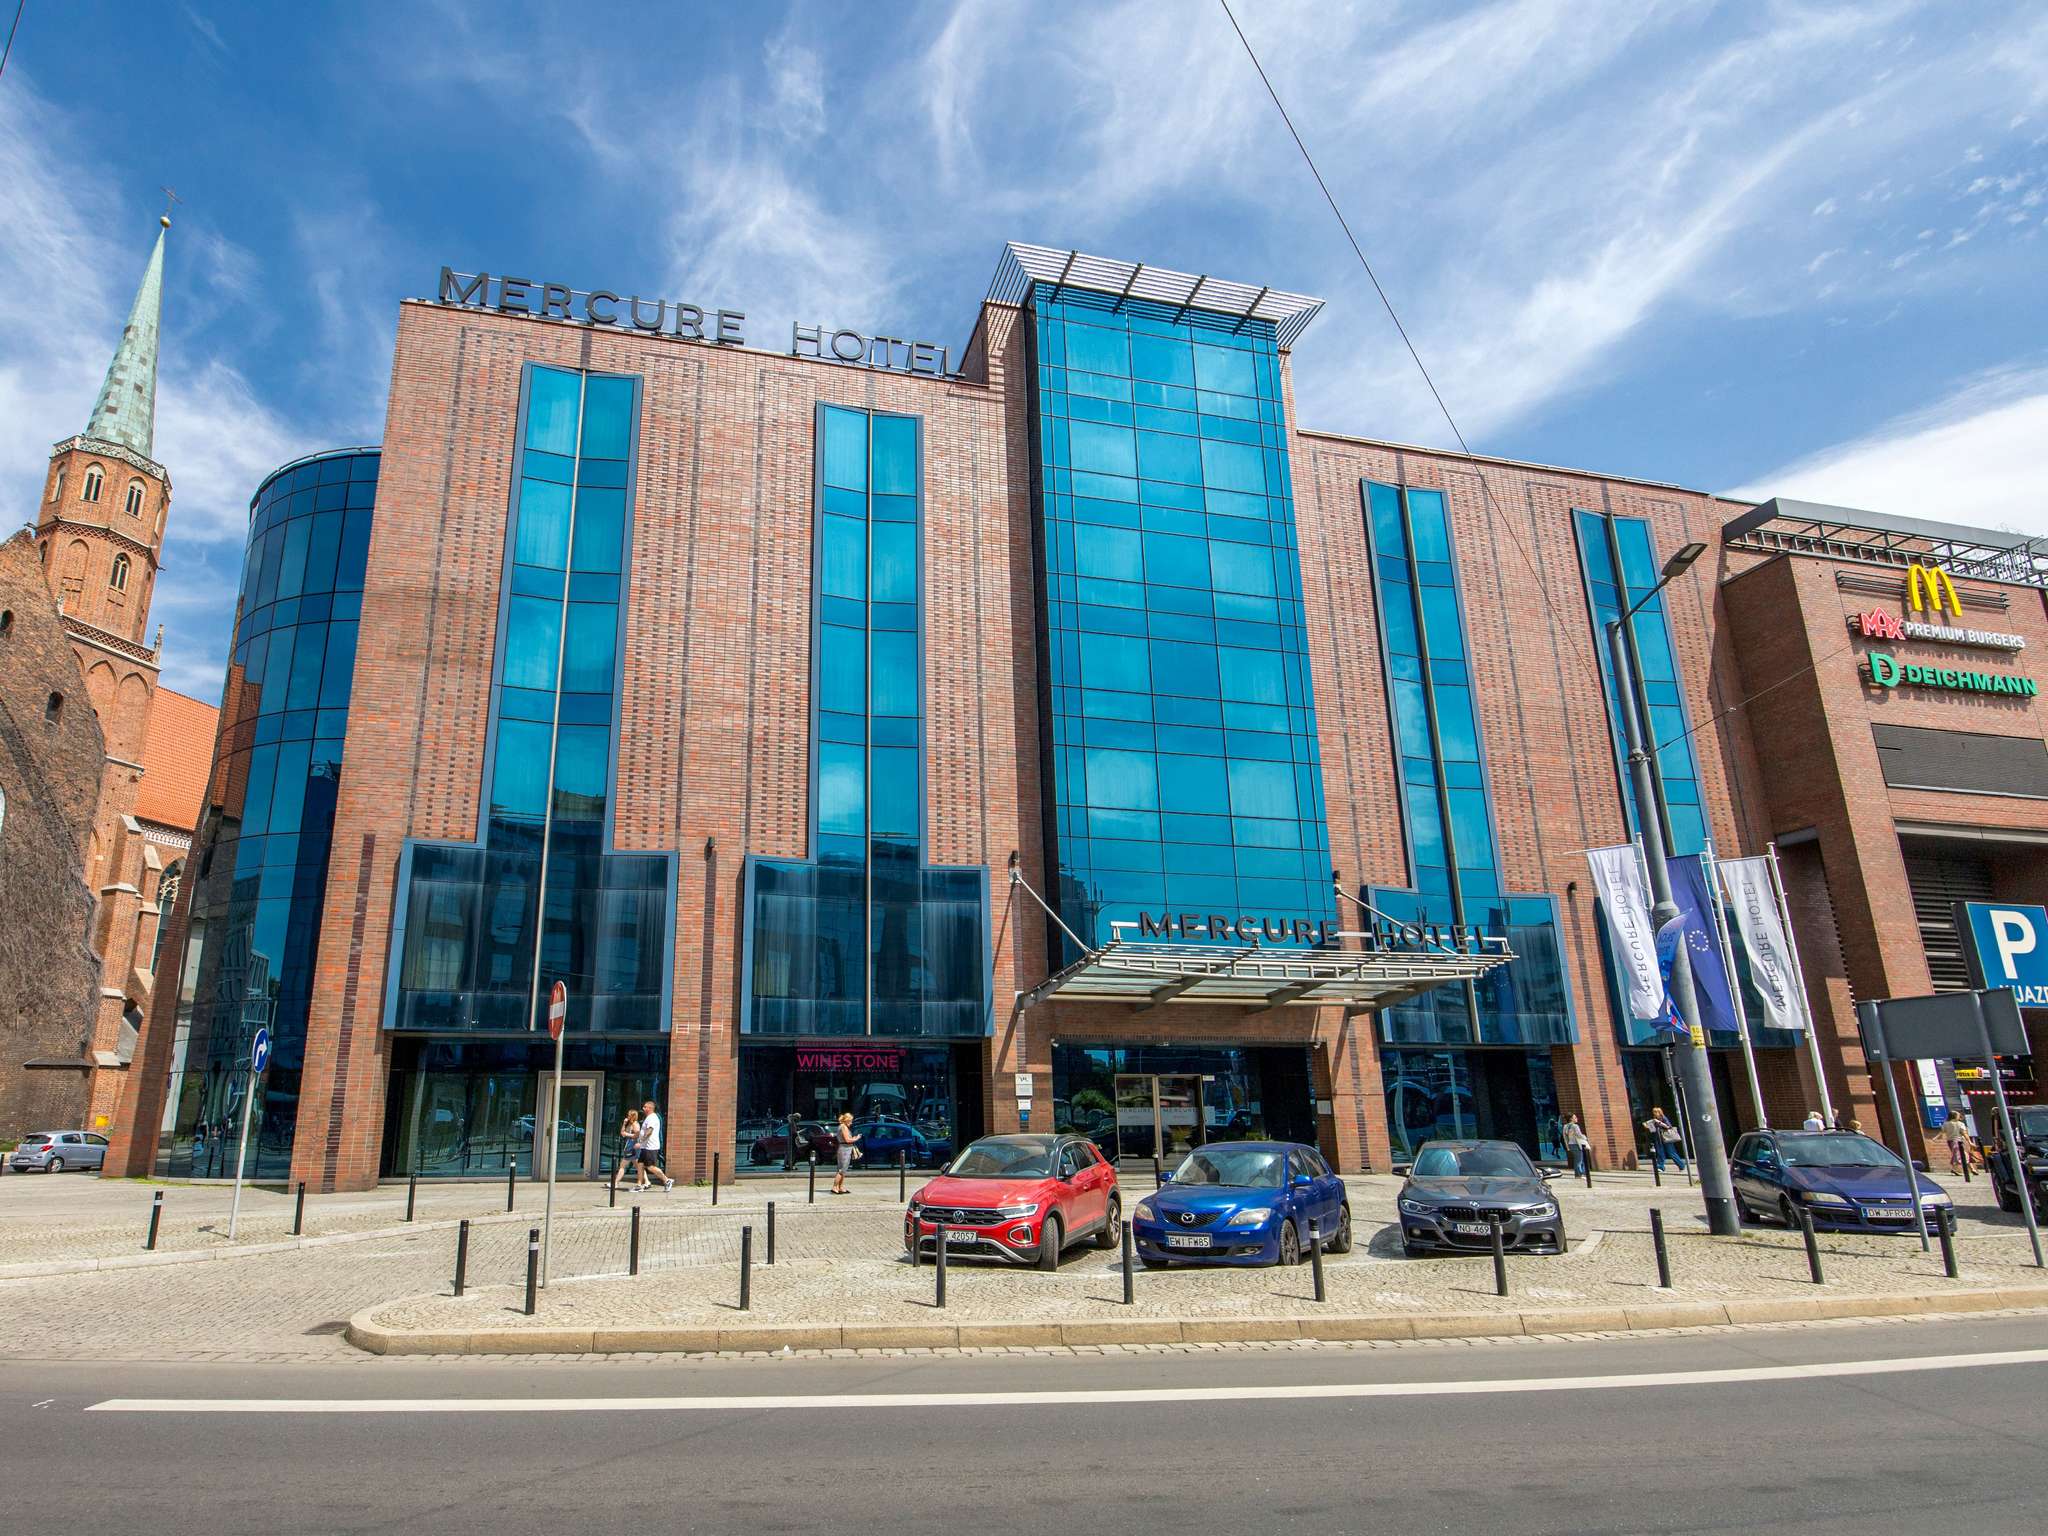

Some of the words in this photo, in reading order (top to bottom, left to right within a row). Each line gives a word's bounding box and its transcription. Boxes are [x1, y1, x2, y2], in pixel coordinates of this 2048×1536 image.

[439, 266, 745, 345] MERCURE
[793, 320, 961, 380] HOTEL
[1861, 607, 1906, 640] MAX
[1905, 622, 1966, 642] PREMIUM
[1967, 629, 2026, 649] BURGERS
[1905, 664, 2039, 697] DEICHMANN
[1139, 911, 1343, 946] MERCURE
[1372, 921, 1495, 951] HOTEL
[1989, 910, 2036, 979] P
[1999, 984, 2048, 1004] JAZ
[797, 1054, 899, 1068] WINESTONE
